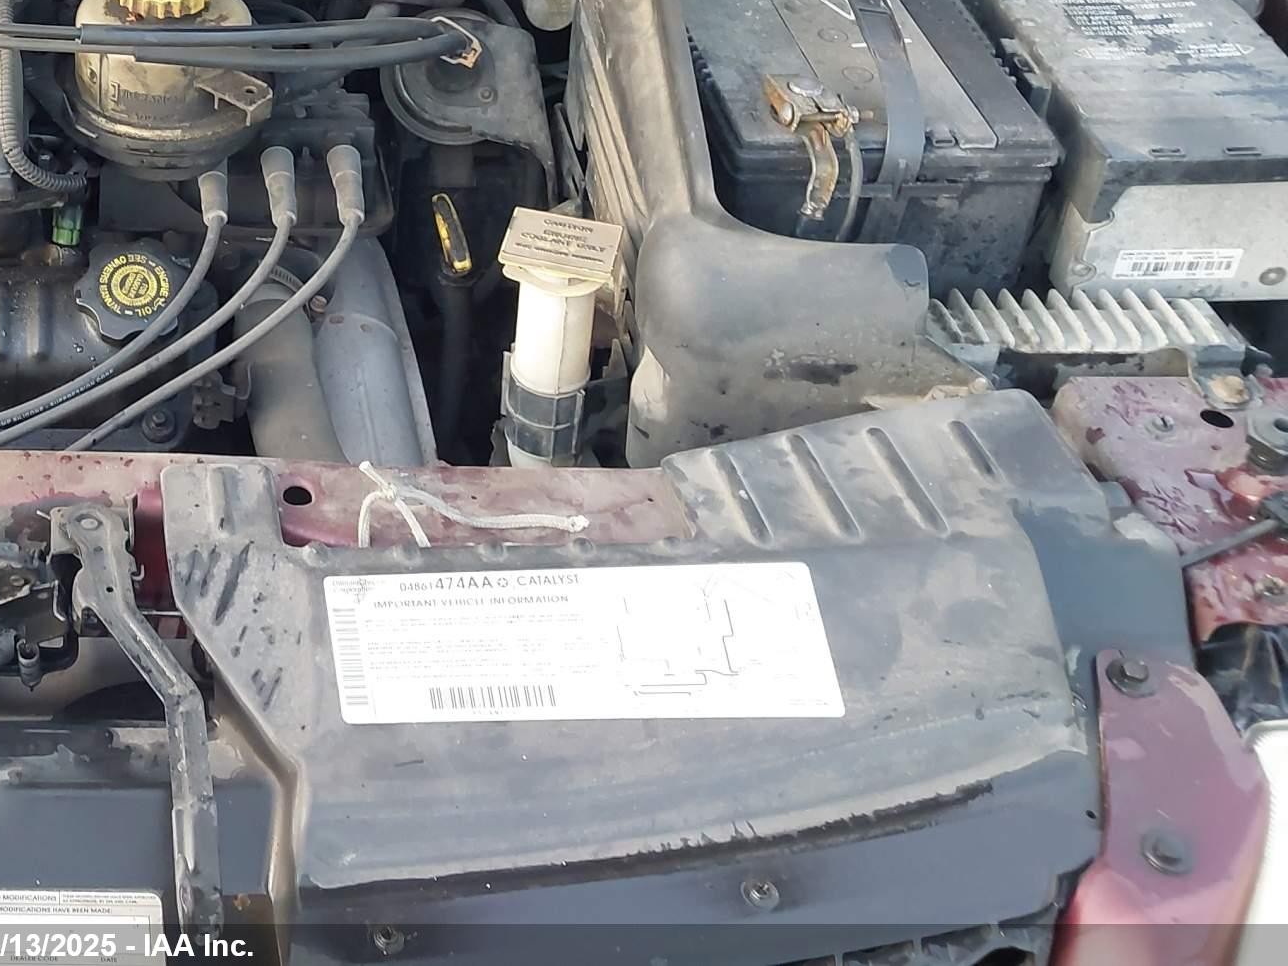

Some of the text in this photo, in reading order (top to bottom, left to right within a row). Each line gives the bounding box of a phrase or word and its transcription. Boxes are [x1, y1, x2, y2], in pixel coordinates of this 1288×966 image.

[543, 219, 593, 233] CAUTION
[521, 232, 606, 252] COOLANT ONLY
[127, 254, 148, 264] SEE
[135, 265, 170, 316] ENGINE OIL
[516, 574, 580, 586] CATALYST
[373, 595, 569, 609] IMPORTANT VEHICLE INFORMATION
[2, 894, 57, 903] MODIFICATIONS
[52, 906, 70, 914] HAVE
